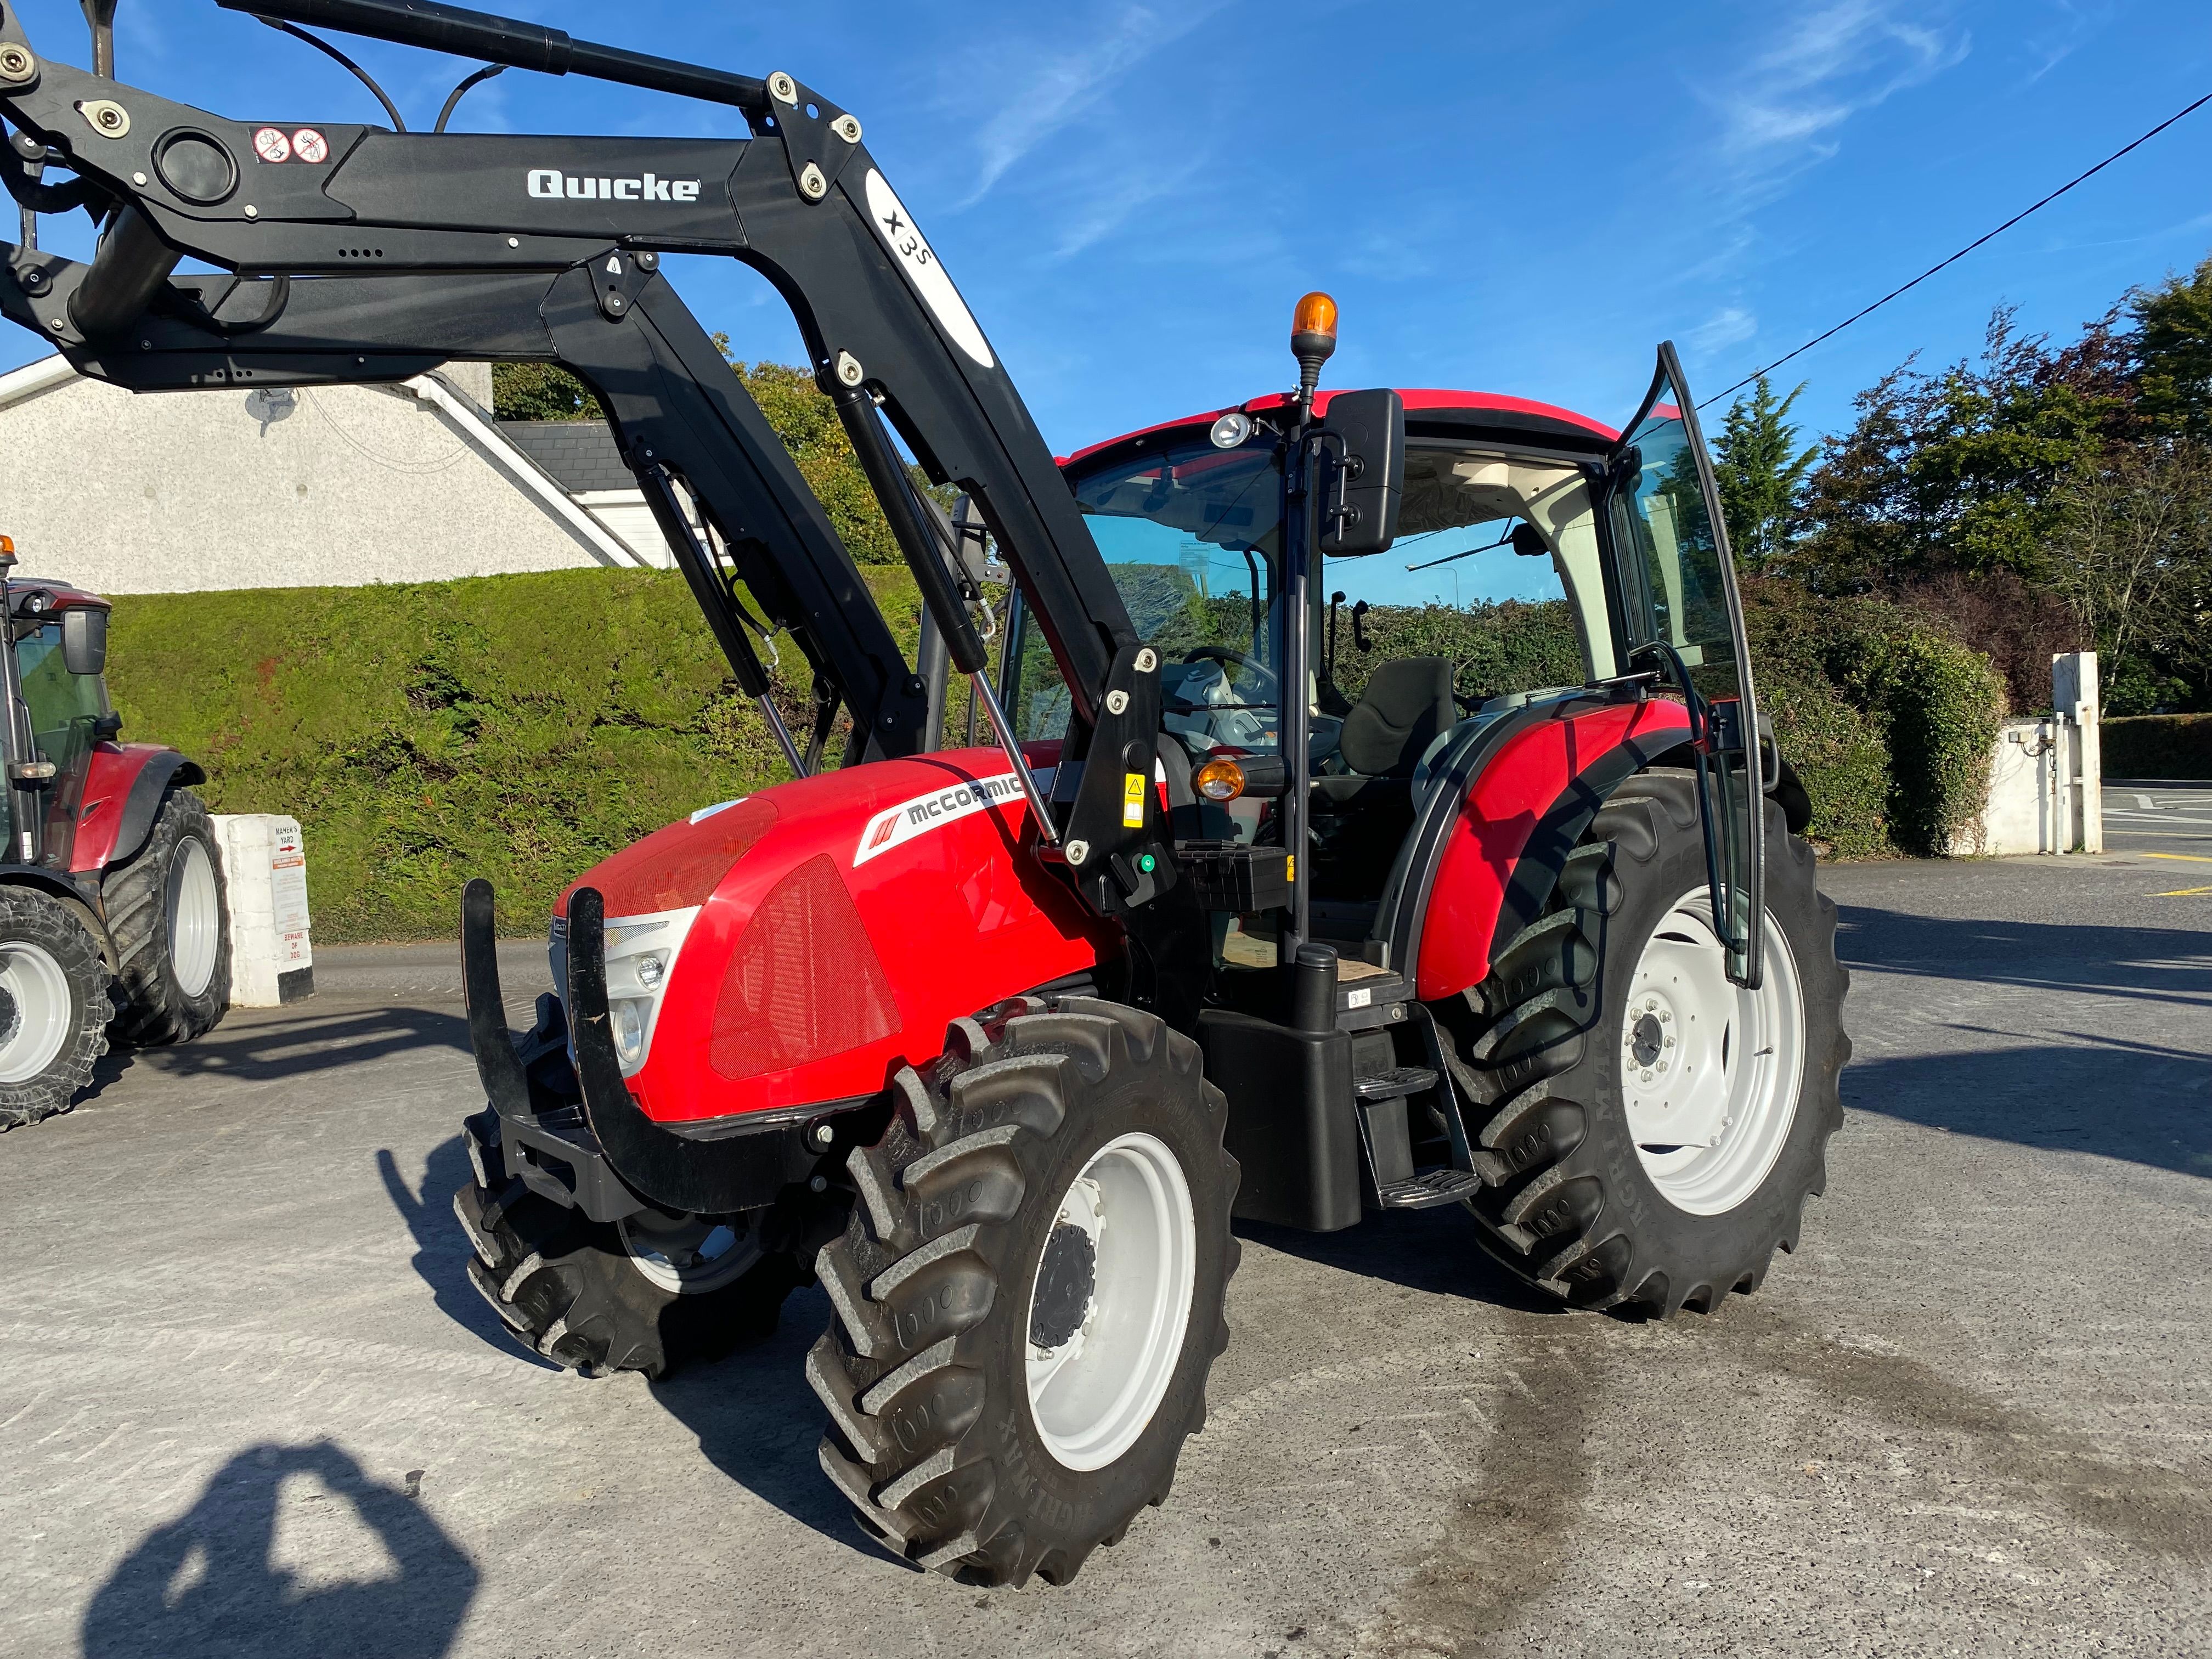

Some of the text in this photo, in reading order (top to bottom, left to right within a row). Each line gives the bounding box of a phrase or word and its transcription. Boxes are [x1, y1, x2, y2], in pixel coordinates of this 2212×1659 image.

[528, 170, 699, 201] Quicke
[275, 825, 297, 834] MAHER'S
[280, 836, 294, 844] YARD
[284, 932, 303, 941] BEWARE
[290, 951, 300, 959] DOG
